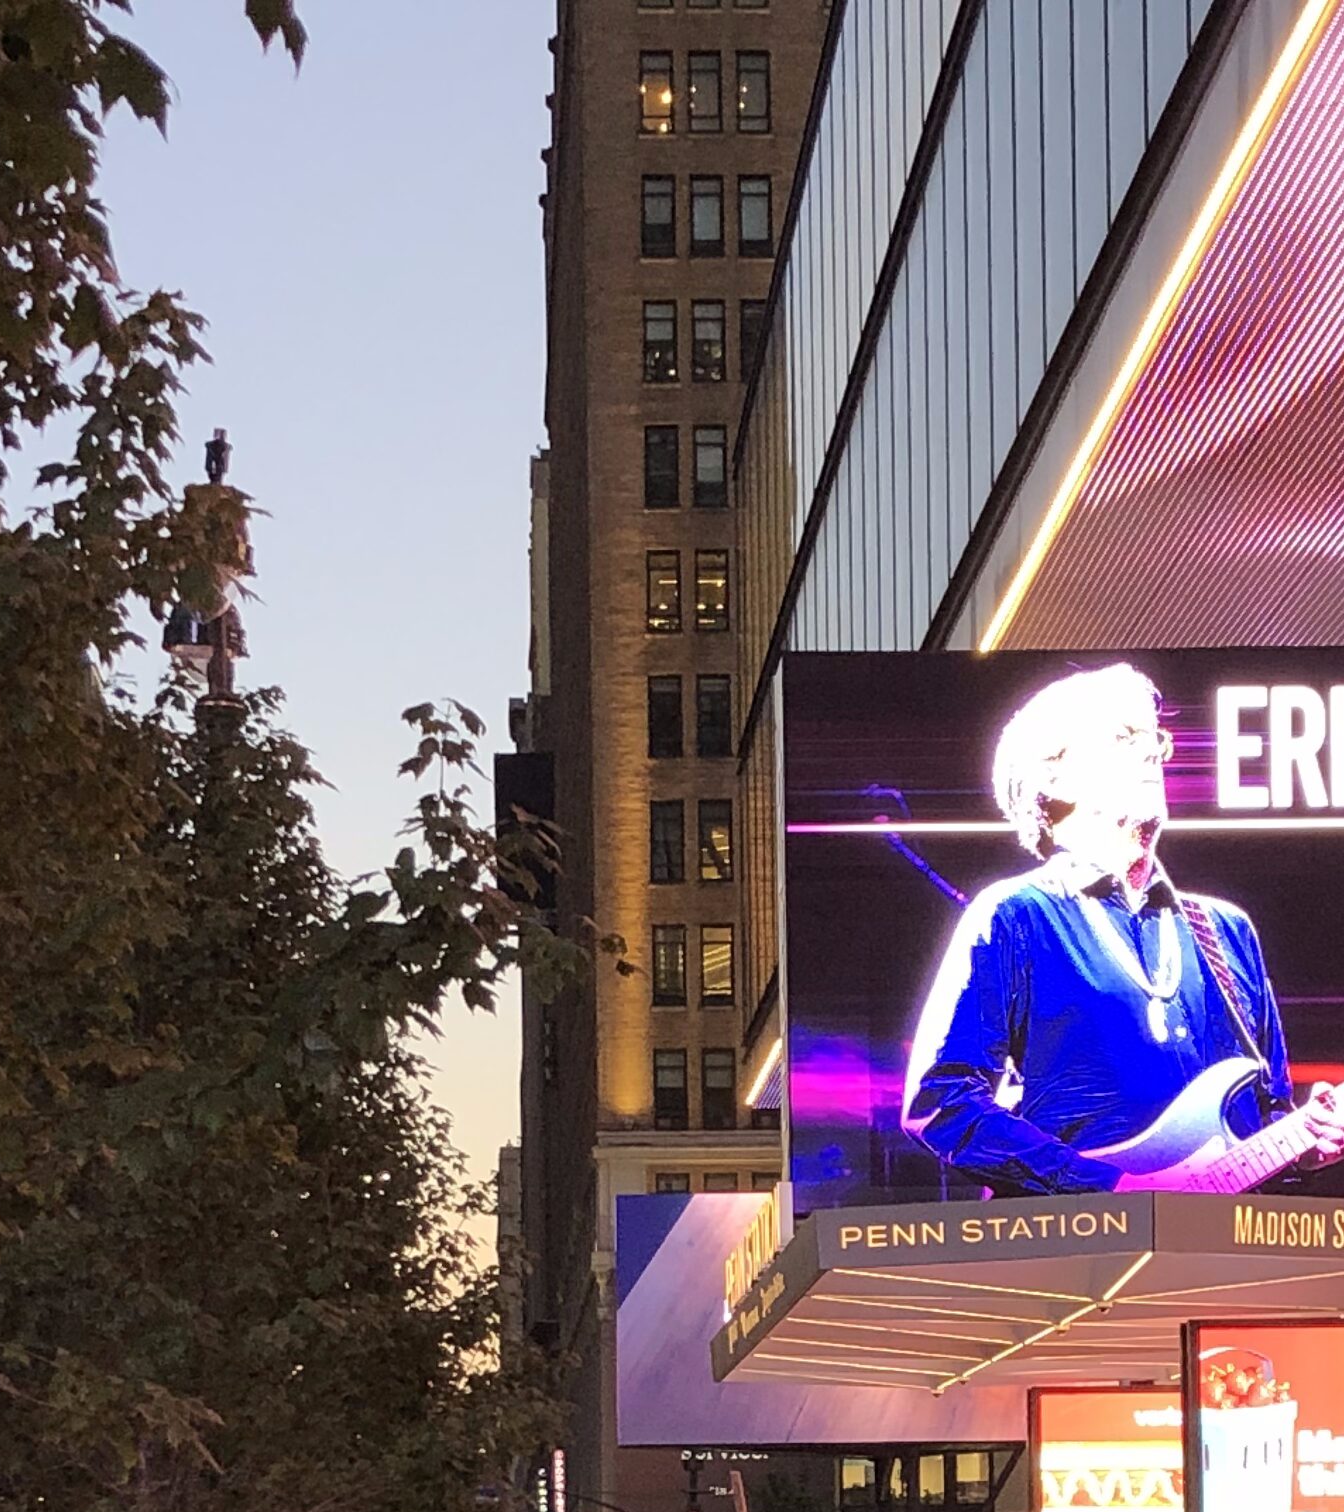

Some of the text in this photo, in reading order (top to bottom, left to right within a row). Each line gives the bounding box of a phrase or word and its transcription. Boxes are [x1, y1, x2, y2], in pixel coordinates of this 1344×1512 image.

[838, 1210, 1129, 1250] PENN STATION
[1233, 1205, 1326, 1248] MADISON
